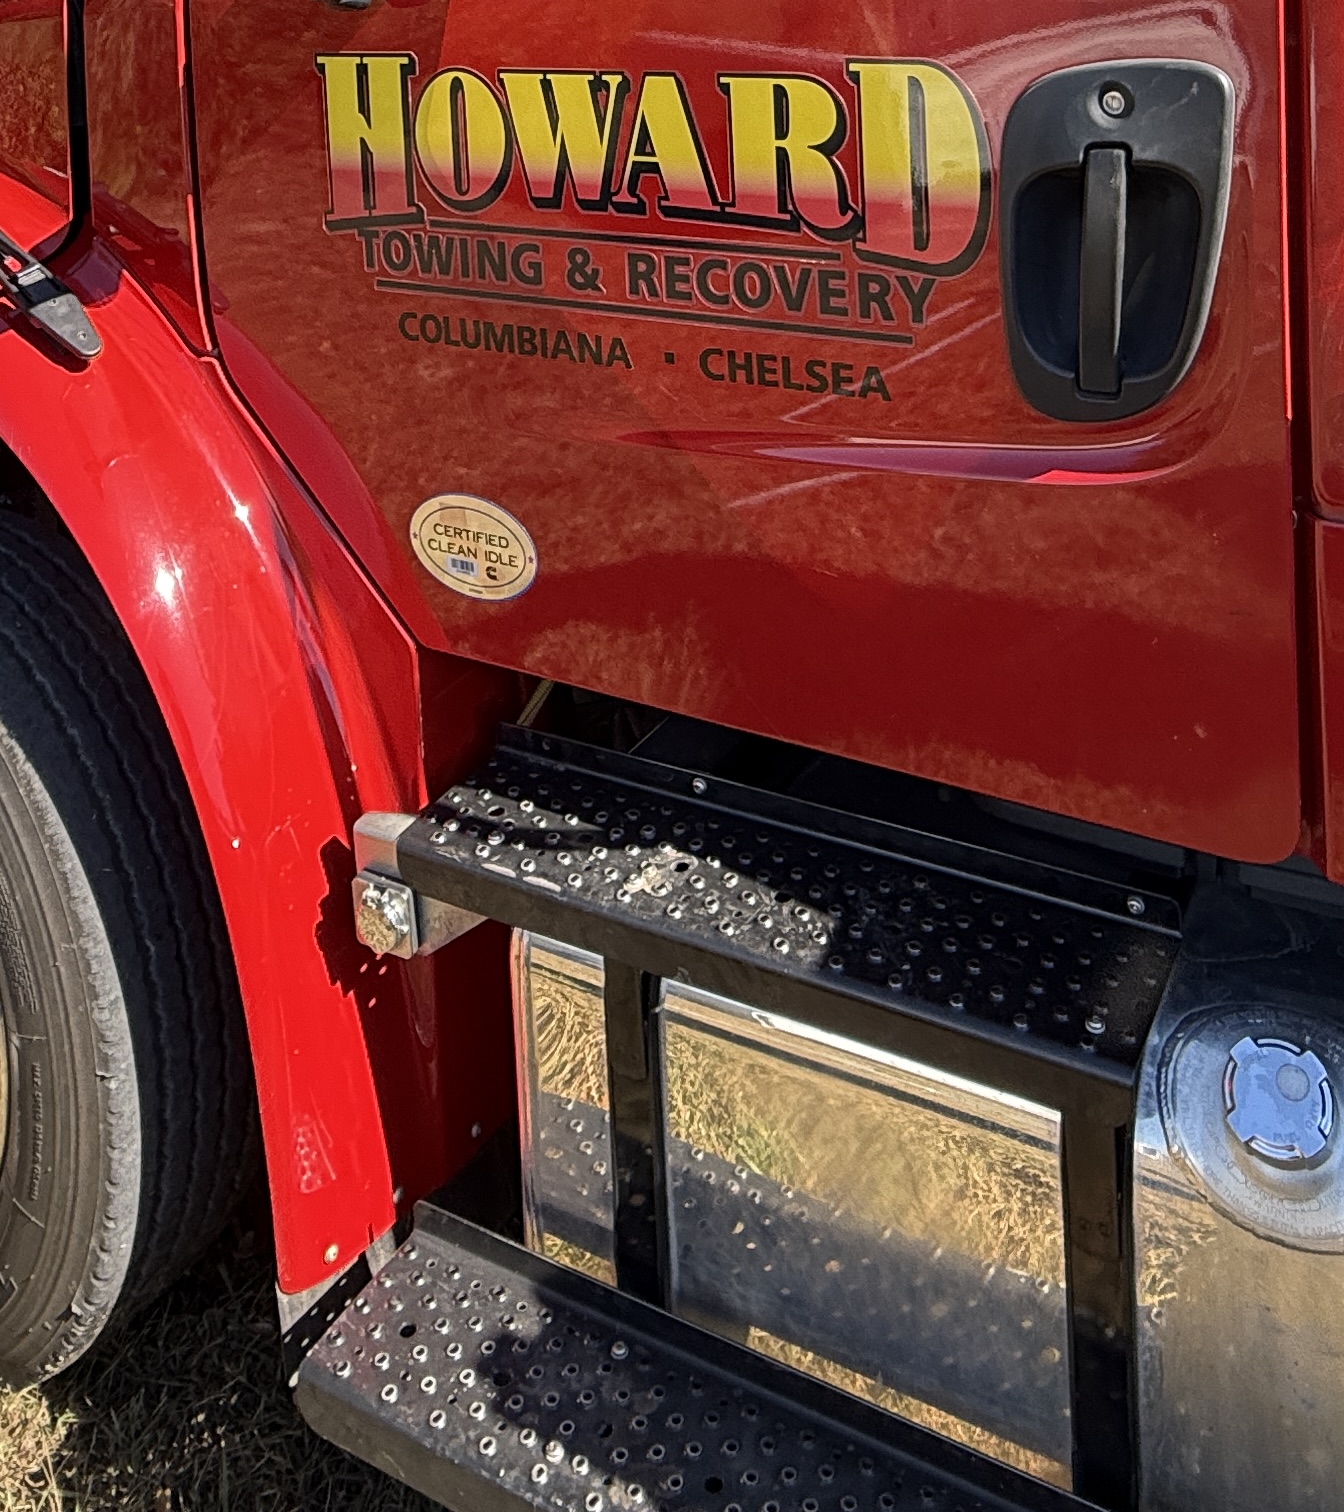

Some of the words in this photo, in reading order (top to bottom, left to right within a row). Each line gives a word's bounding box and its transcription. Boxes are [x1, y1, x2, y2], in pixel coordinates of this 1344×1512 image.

[316, 52, 992, 276] HOWARD
[357, 227, 543, 287] TOWING
[566, 246, 605, 292] &
[627, 251, 937, 326] RECOVERY
[399, 311, 633, 369] COLUMBIANA
[700, 348, 892, 402] CHELSEA
[428, 538, 478, 560] CLEAN
[484, 550, 518, 569] IDLE
[433, 523, 510, 549] CERTIFIED
